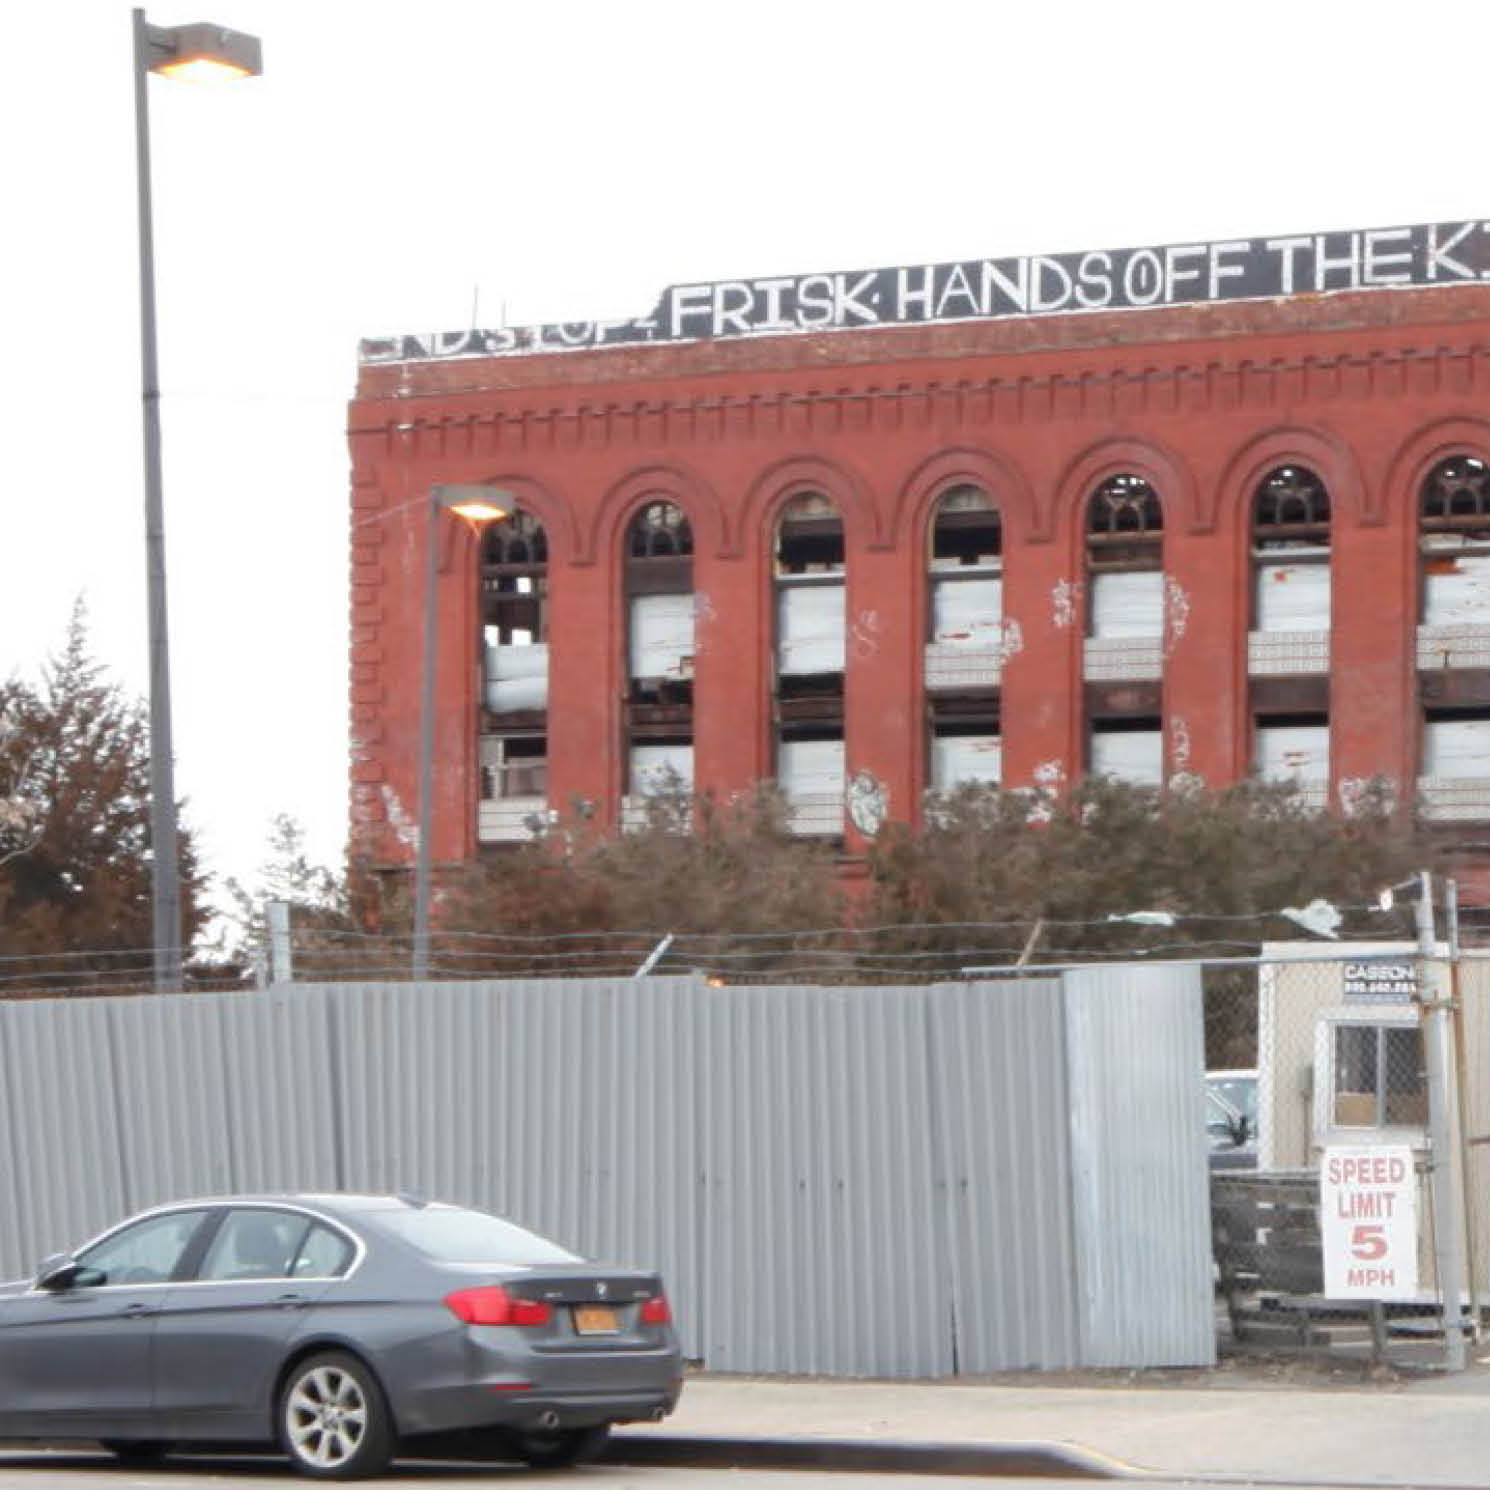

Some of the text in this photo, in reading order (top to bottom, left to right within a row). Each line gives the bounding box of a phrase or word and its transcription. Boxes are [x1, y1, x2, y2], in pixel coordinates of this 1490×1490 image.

[671, 272, 878, 336] FRISK
[899, 252, 1111, 319] HANDS
[1124, 241, 1251, 305] OFF
[1266, 228, 1412, 294] THE
[1328, 1157, 1405, 1184] SPEED
[1338, 1192, 1396, 1218] LIMIT
[1351, 1225, 1388, 1260] 5
[1347, 1269, 1395, 1287] MPH
